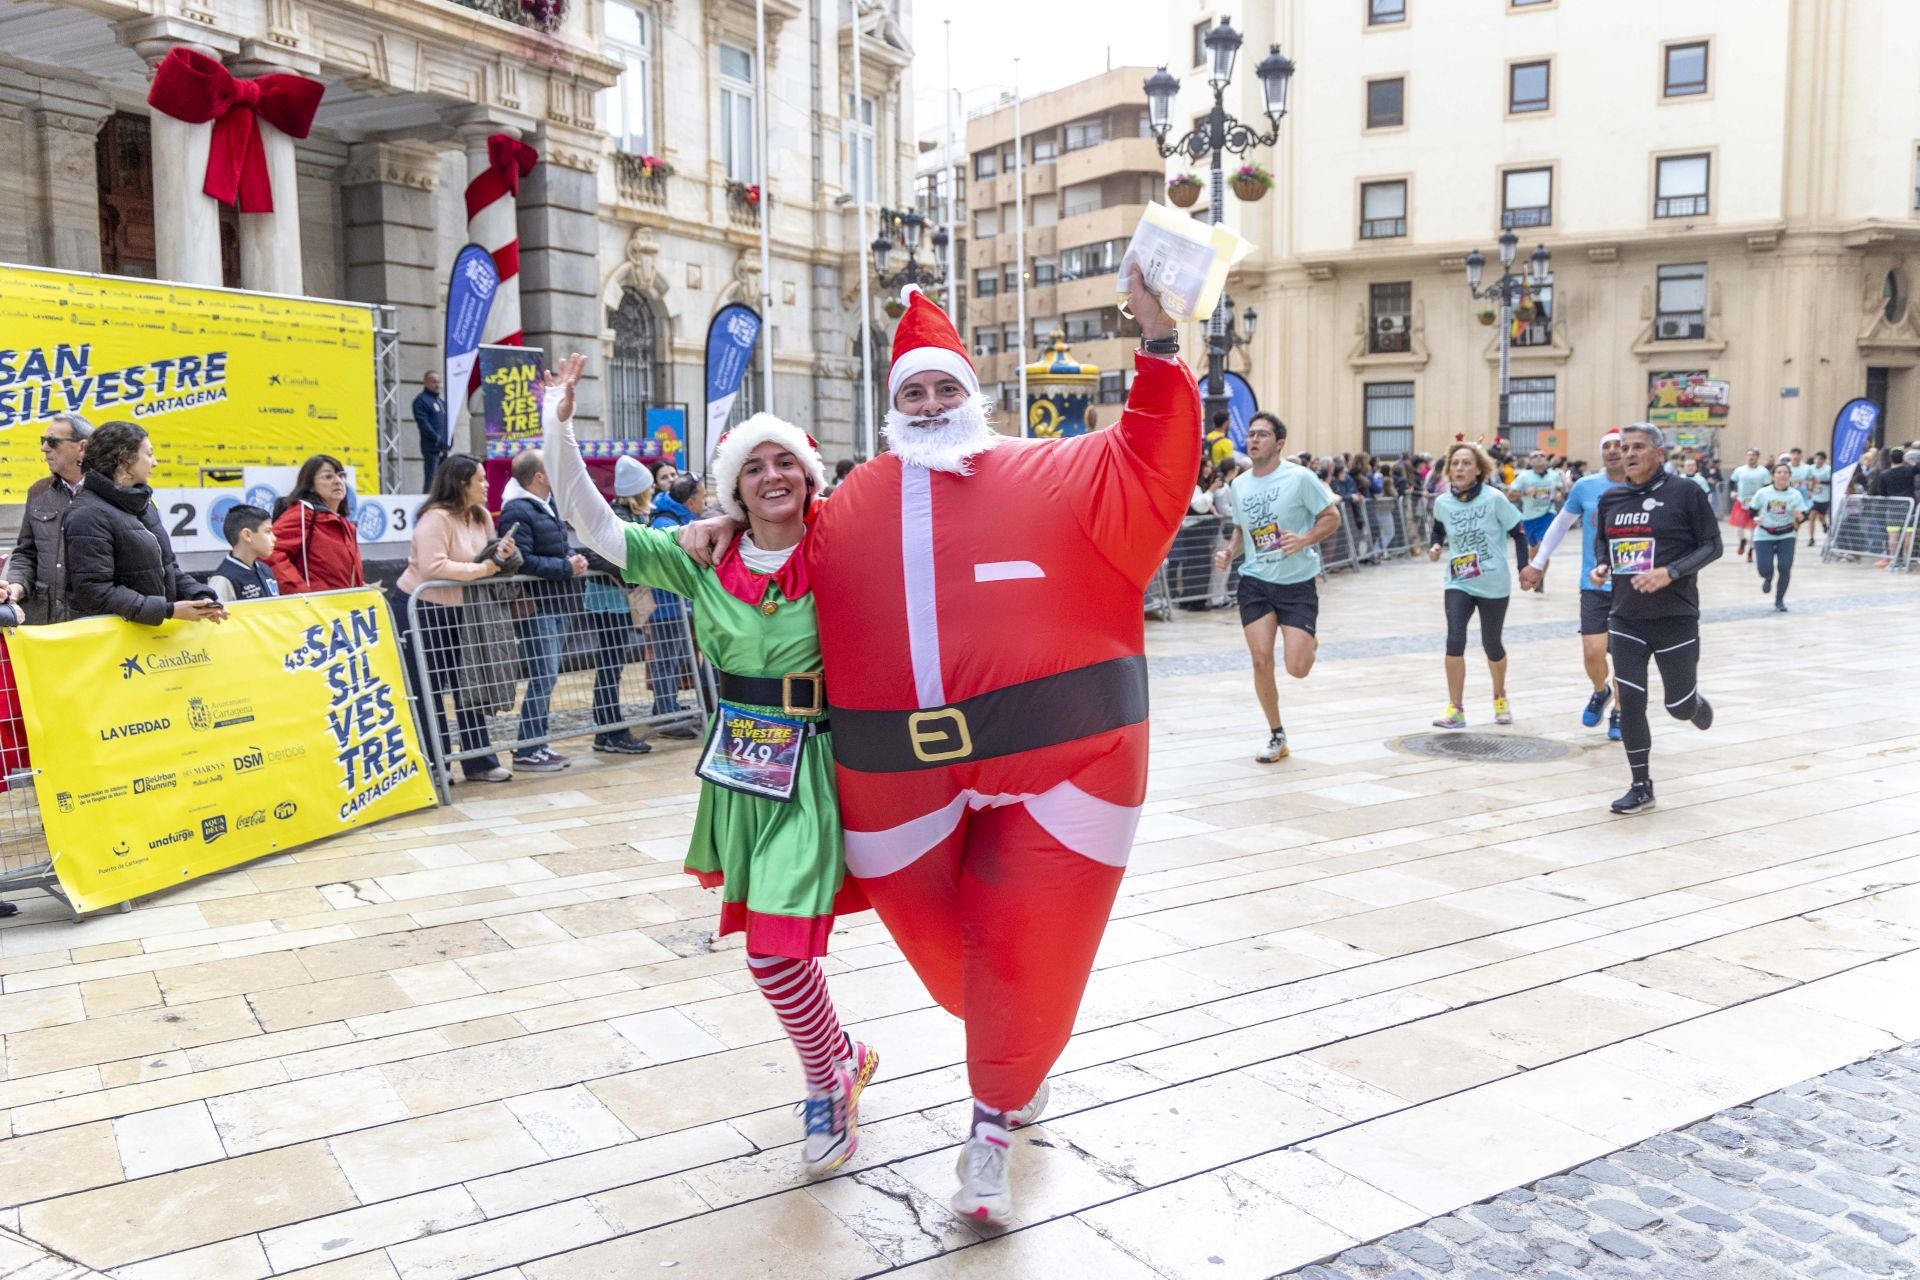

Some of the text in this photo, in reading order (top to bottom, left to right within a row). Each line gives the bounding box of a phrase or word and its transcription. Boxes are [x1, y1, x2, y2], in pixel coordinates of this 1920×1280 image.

[0, 343, 89, 386] SAN
[497, 364, 536, 385] SAN
[0, 352, 228, 427] SILVESTRE
[504, 381, 532, 401] SIL
[134, 387, 228, 417] CARTAGENA
[268, 407, 294, 415] VERDAD
[502, 396, 537, 417] VES
[503, 413, 540, 433] TRE
[170, 503, 197, 536] 2
[393, 508, 407, 530] 3
[1449, 505, 1487, 525] SAN
[1614, 512, 1650, 526] UNED
[1617, 551, 1645, 564] 1614
[304, 606, 378, 668] SAN
[146, 648, 211, 670] CaixaBank
[324, 650, 380, 706] SIL
[324, 684, 395, 748] VES
[732, 719, 754, 729] SAN
[101, 718, 170, 740] LA VERDAD
[731, 728, 793, 738] SILVESTRE
[233, 752, 264, 771] DSM
[338, 724, 406, 790] TRE
[732, 738, 772, 767] 249
[145, 773, 176, 784] BeUrban
[146, 780, 177, 792] Running
[340, 760, 418, 819] CARTAGENA
[204, 817, 225, 829] AQUA
[205, 825, 225, 836] DEUS
